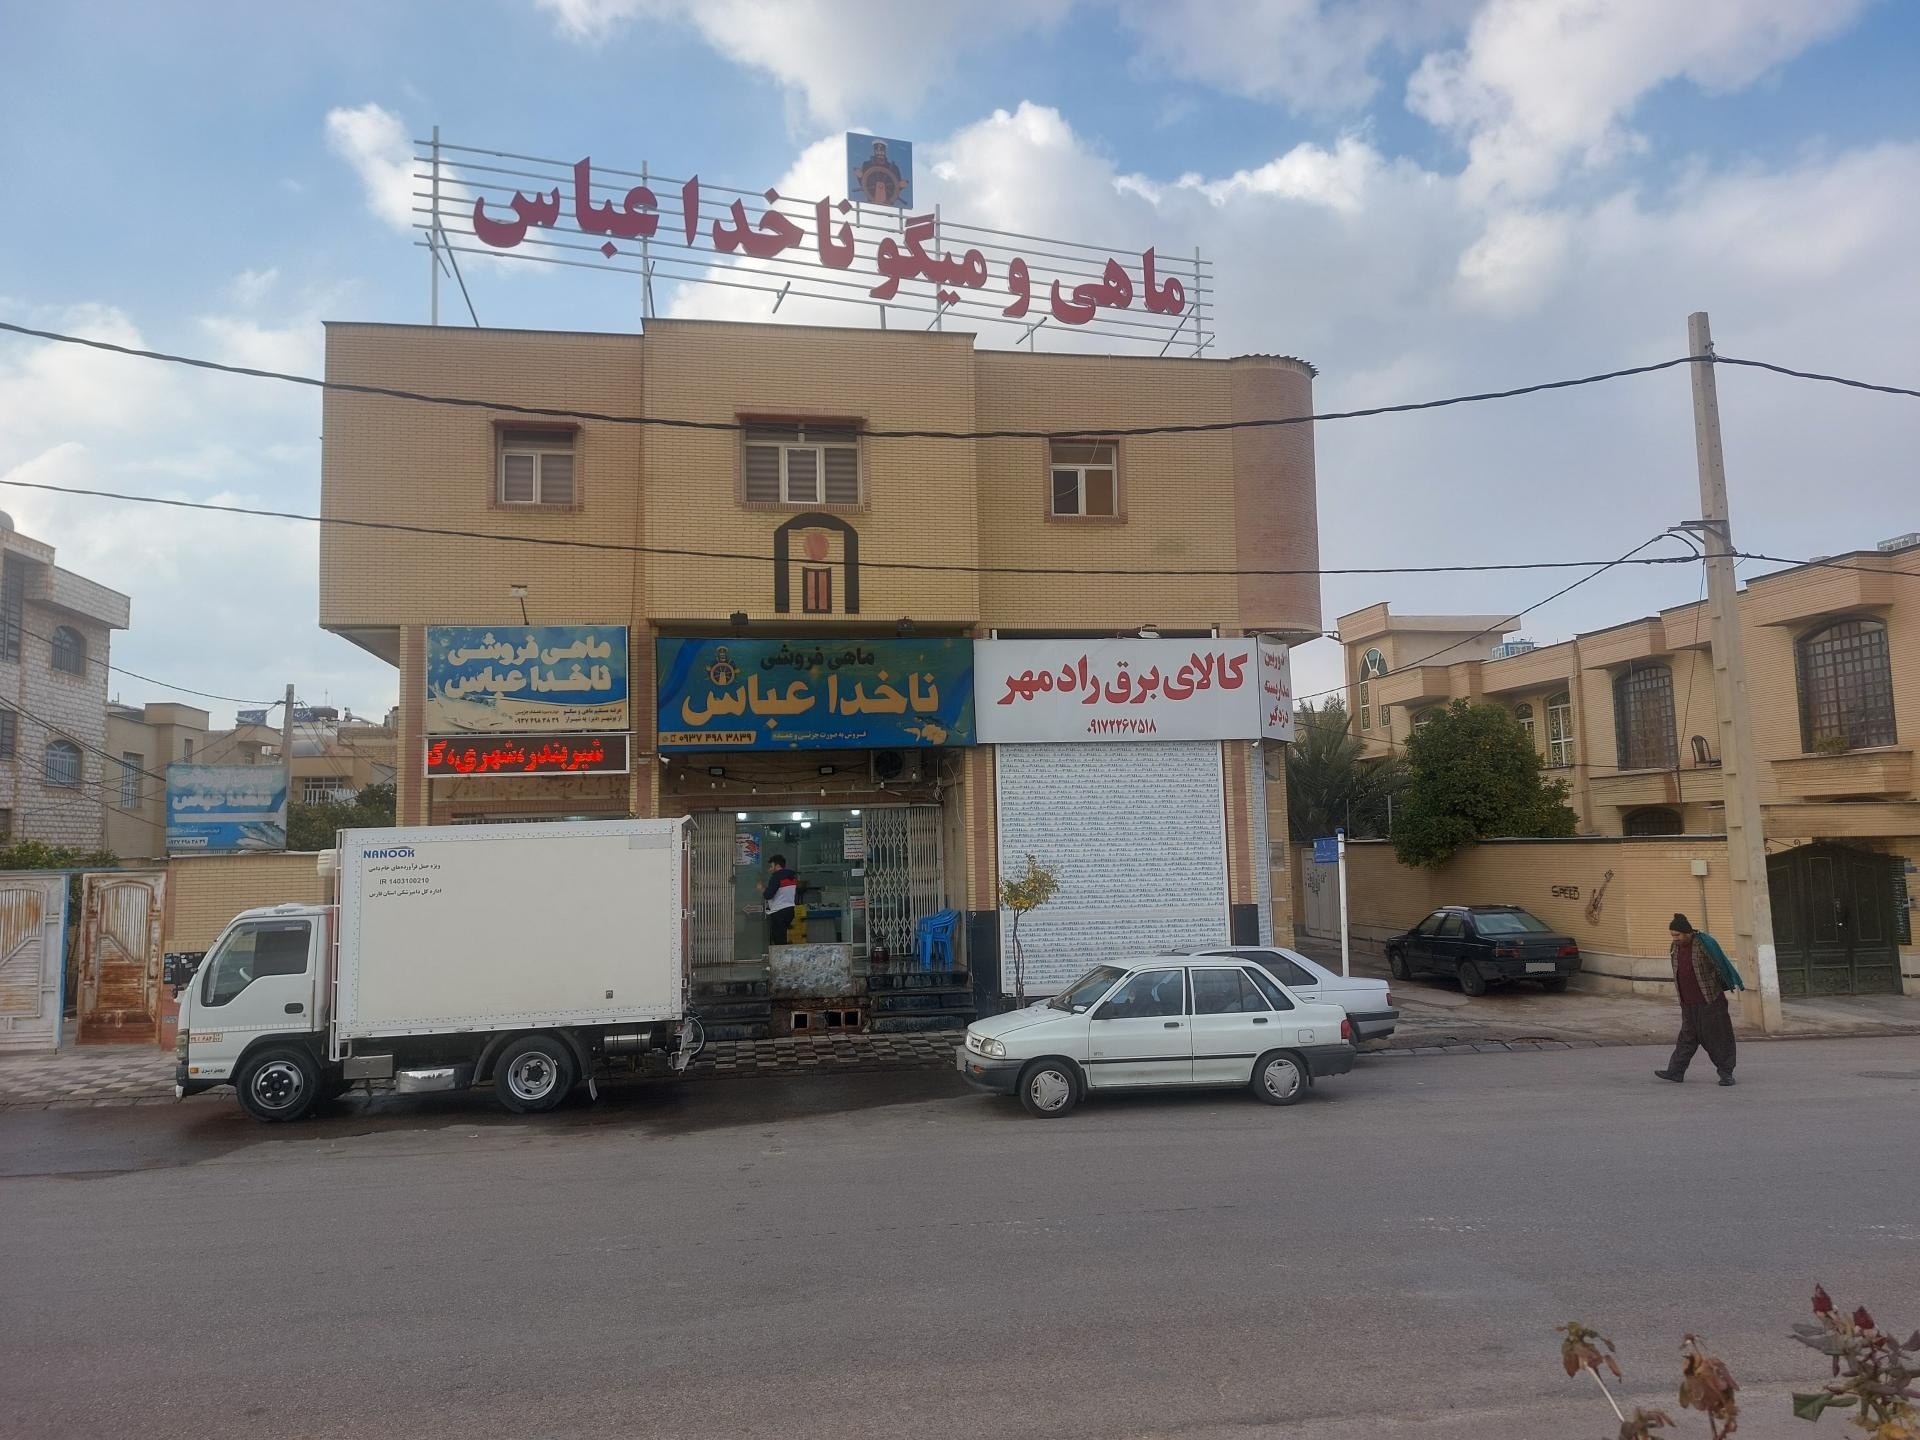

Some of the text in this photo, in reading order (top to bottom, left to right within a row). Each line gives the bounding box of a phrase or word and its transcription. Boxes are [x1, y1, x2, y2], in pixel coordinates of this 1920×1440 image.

[473, 156, 1186, 325] ماهی و میگو ناخدا عباس
[447, 632, 612, 666] ماهی فروشی
[760, 644, 875, 671] ماهی فروشی
[444, 663, 612, 699] ناخدا عباس
[1163, 652, 1248, 701] کالای
[681, 670, 939, 729] ناخدا عباس
[1268, 704, 1289, 728] دزدگیر
[679, 733, 703, 743] ۰۹۳۷
[725, 733, 752, 742] ۳۸۳۹
[566, 739, 604, 770] شیر
[363, 849, 415, 859] NANOOK
[1551, 885, 1580, 900] SPEED
